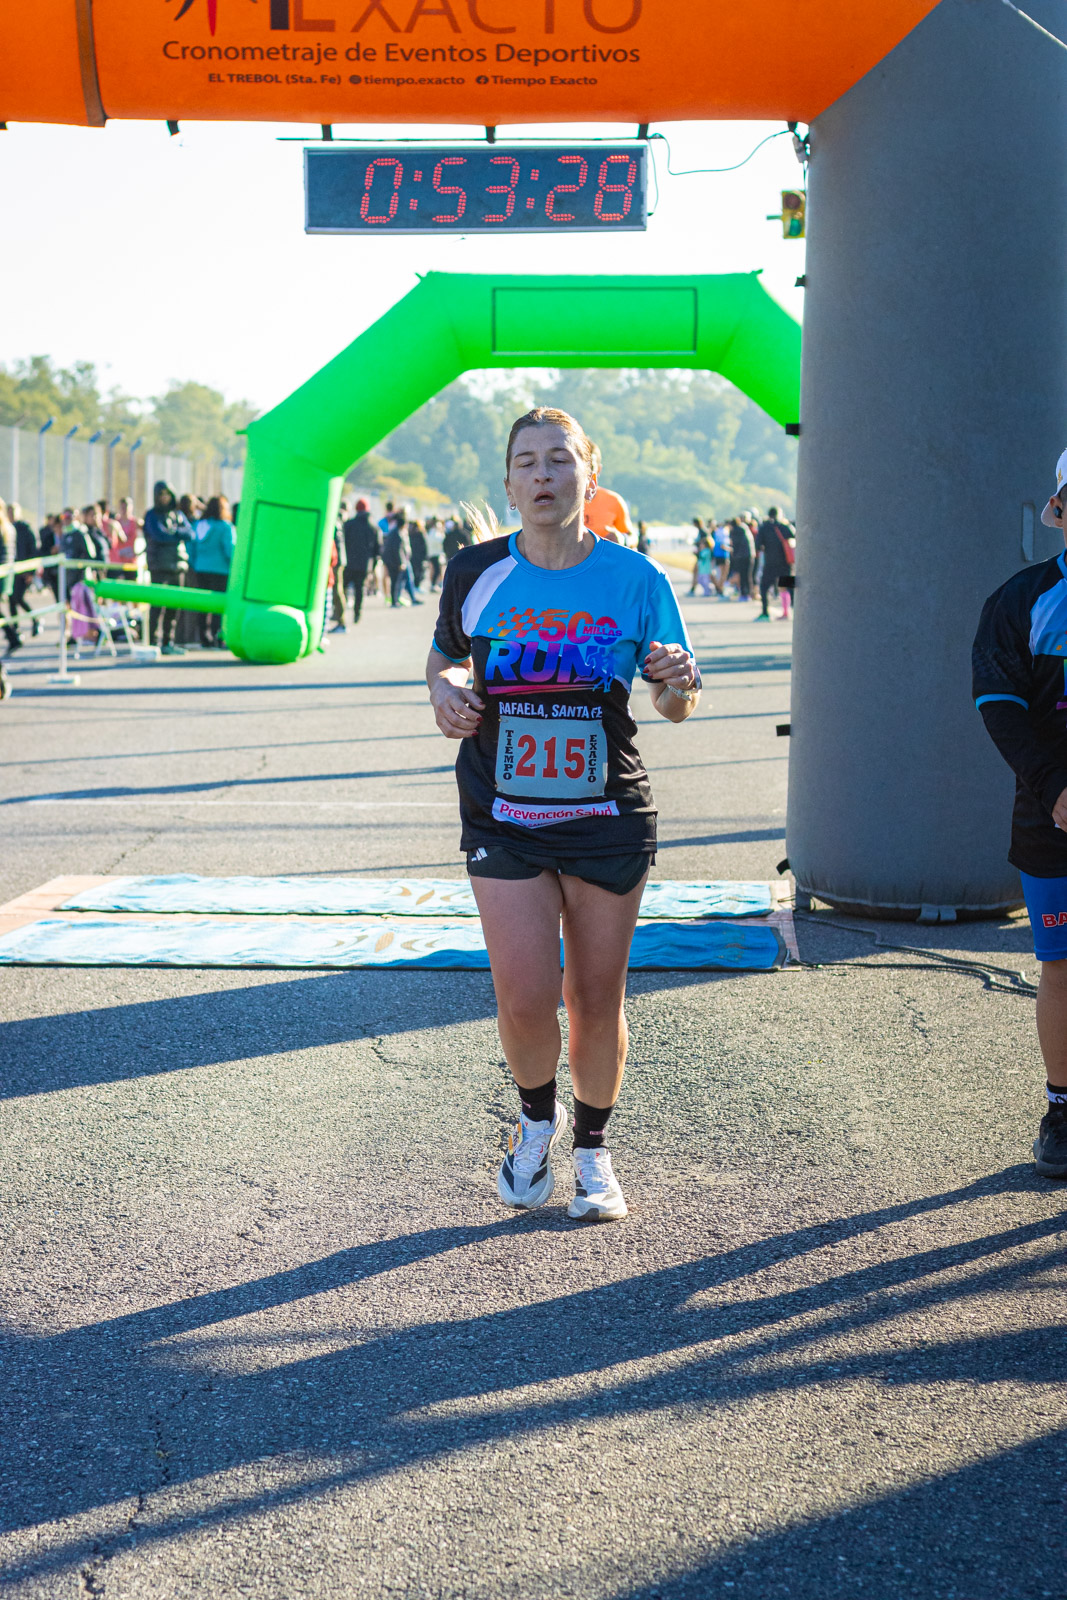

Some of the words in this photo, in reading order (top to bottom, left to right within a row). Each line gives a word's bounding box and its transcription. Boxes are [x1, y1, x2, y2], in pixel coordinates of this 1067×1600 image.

[162, 41, 338, 66] Cronometraje
[345, 42, 377, 62] de
[385, 43, 487, 63] Eventos
[496, 43, 640, 67] Deportivos
[208, 73, 223, 83] EL
[227, 73, 282, 84] TREBOL
[285, 73, 317, 85] (Sta.
[320, 74, 342, 86] Fe)
[364, 75, 465, 87] tiempo.exacto
[491, 75, 546, 87] Tiempo
[550, 75, 598, 86] Exacto
[360, 155, 637, 224] 0:53:28
[582, 625, 623, 637] MILLAS
[485, 640, 607, 684] RUN
[498, 701, 548, 719] RAFAELA,
[551, 704, 589, 718] SANTA
[502, 729, 514, 780] TIEMPO
[515, 734, 586, 780] 215
[587, 734, 598, 783] EXACTO
[500, 803, 573, 820] Prevención
